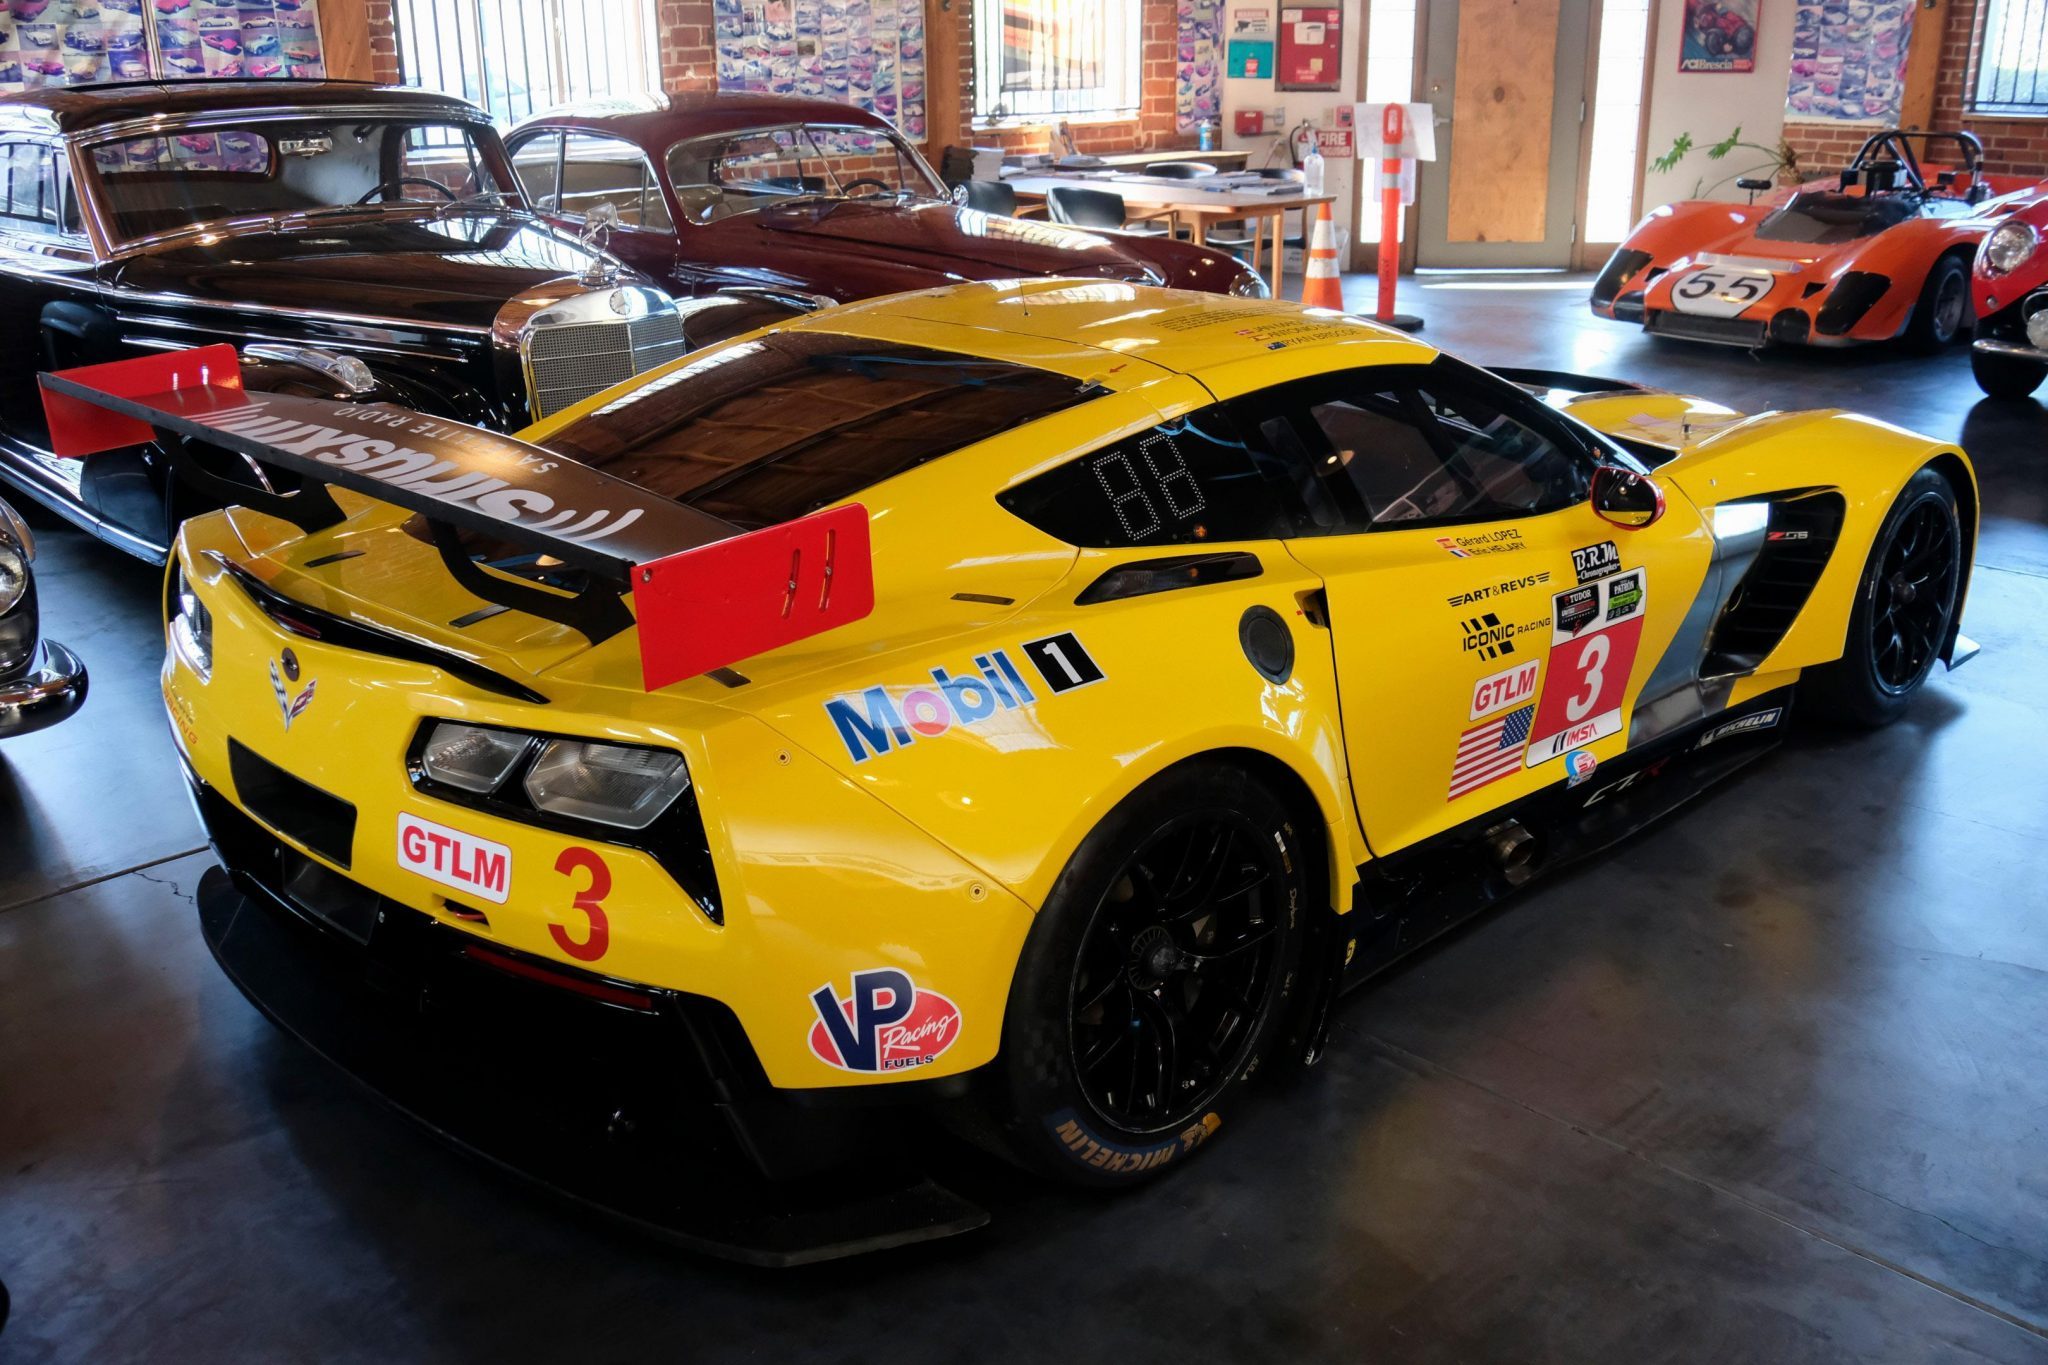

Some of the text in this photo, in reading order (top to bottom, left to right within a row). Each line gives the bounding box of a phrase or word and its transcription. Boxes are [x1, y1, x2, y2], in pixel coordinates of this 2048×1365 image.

[1317, 132, 1347, 146] FIRE
[1679, 272, 1769, 300] 55
[334, 406, 413, 429] RADIO
[1456, 528, 1522, 547] Gérard LOPEZ
[1767, 531, 1809, 541] Z06
[1570, 589, 1592, 603] TUDOR
[1463, 617, 1551, 652] ICONIC RACING
[1474, 666, 1536, 712] GTLM
[1566, 634, 1610, 722] 3
[823, 641, 1084, 764] Mobil 1
[1566, 722, 1598, 746] IMSA
[1715, 712, 1777, 737] MICHELIN
[402, 825, 506, 893] GTLM
[547, 846, 612, 962] 3
[809, 967, 915, 1073] VP
[883, 1011, 961, 1059] Racing
[884, 1055, 935, 1069] FUELS
[1055, 1118, 1177, 1172] MICHELIN
